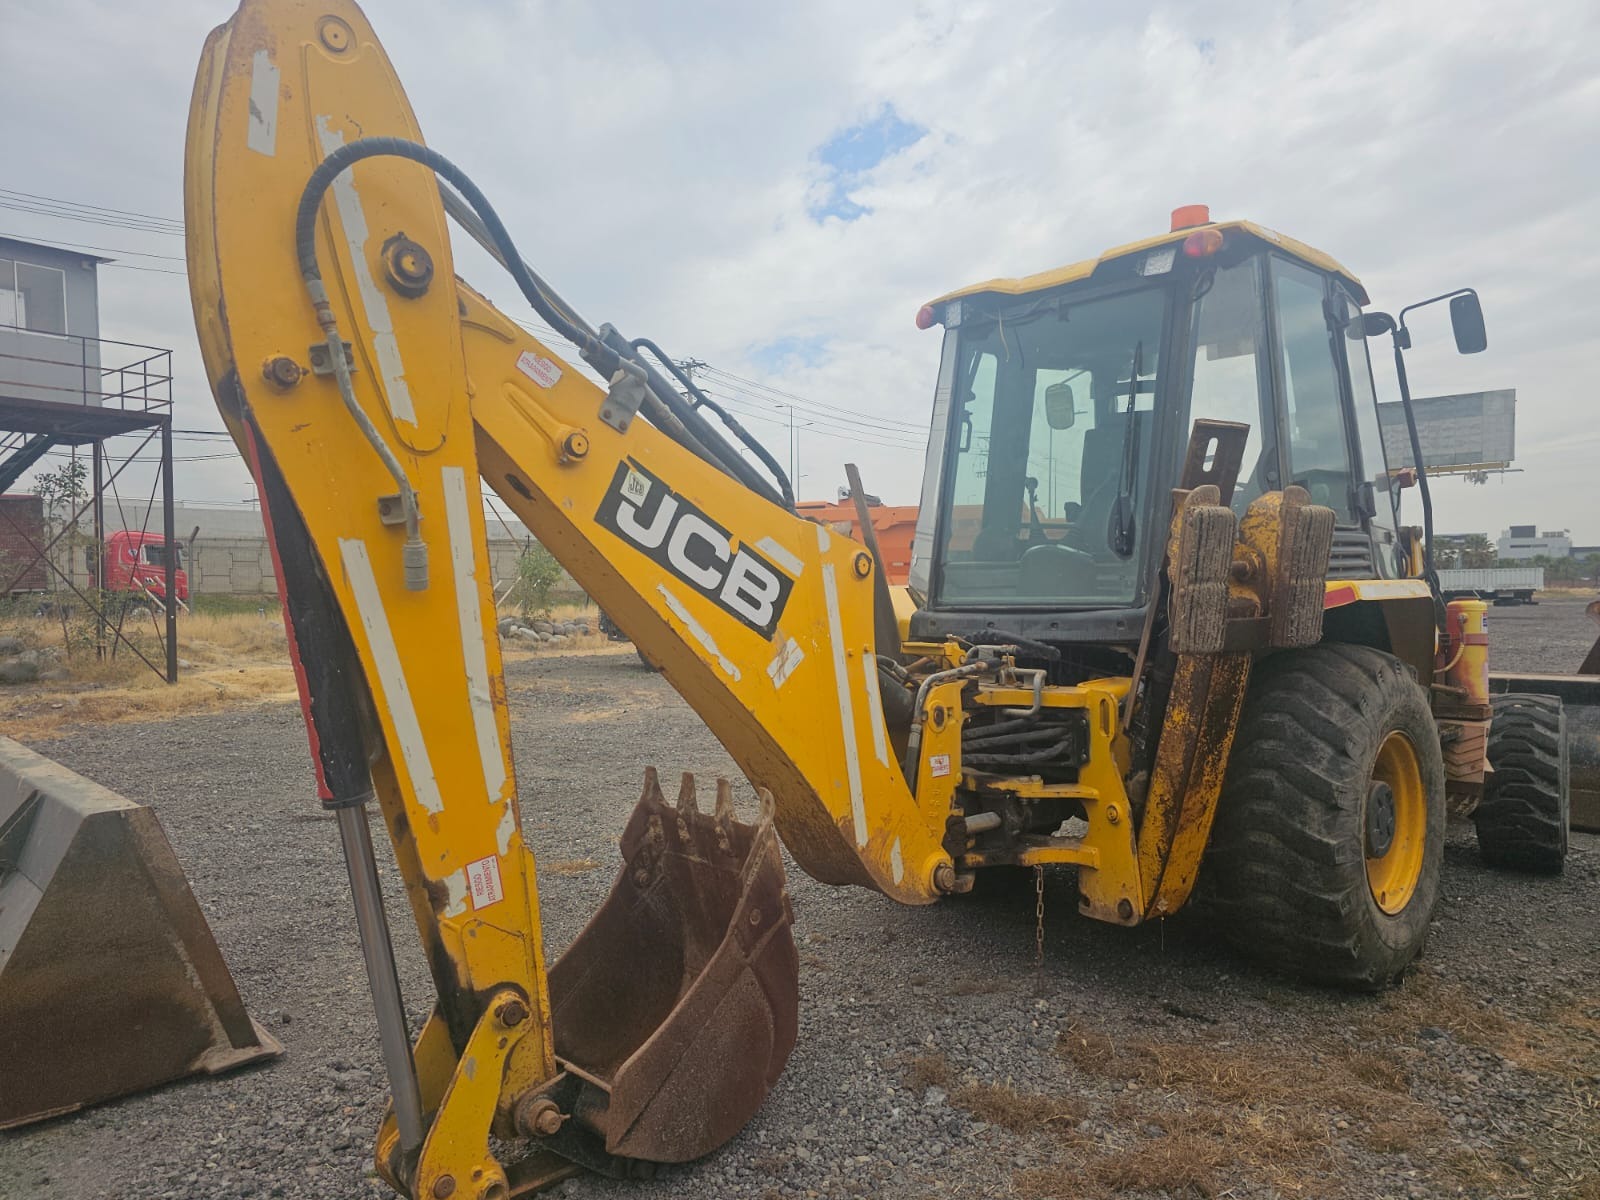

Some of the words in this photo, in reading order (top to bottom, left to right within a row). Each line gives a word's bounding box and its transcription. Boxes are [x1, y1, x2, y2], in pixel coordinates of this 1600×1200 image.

[628, 474, 645, 494] JCB
[616, 494, 780, 626] JCB
[473, 873, 484, 896] RIESGO
